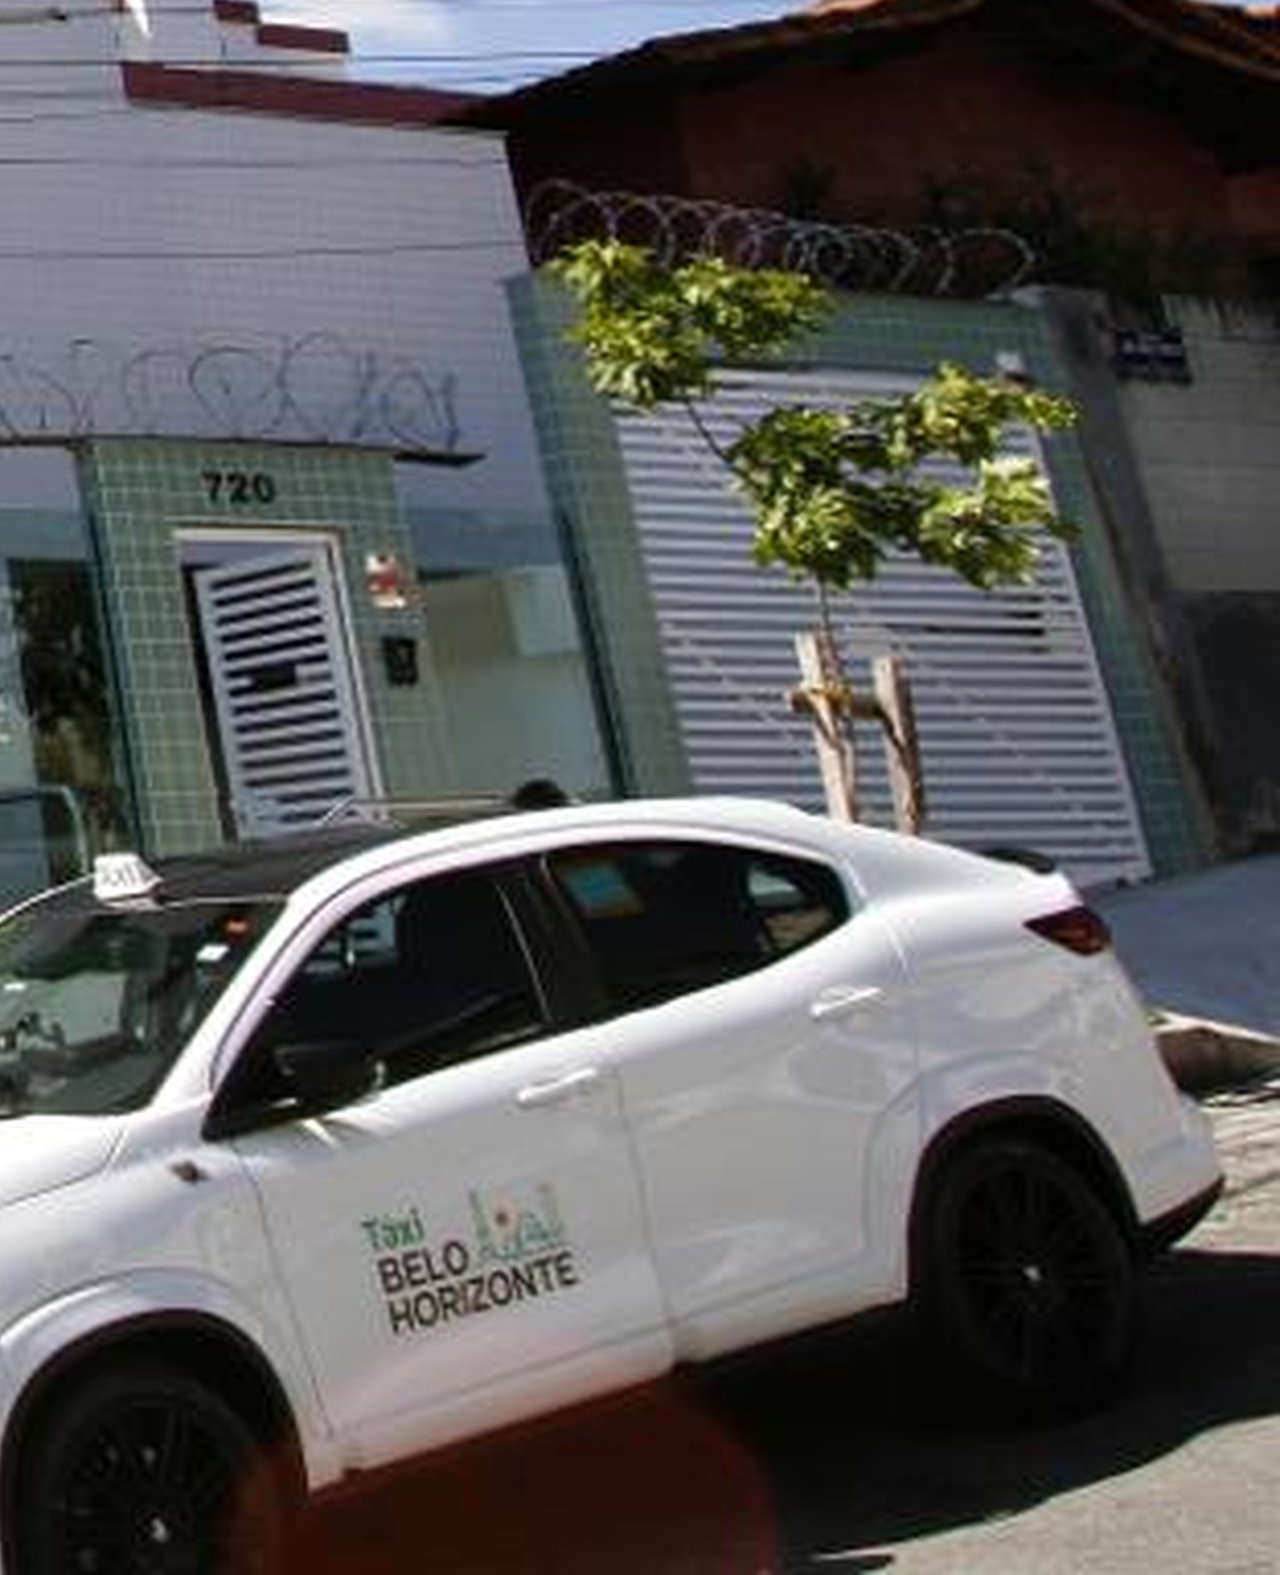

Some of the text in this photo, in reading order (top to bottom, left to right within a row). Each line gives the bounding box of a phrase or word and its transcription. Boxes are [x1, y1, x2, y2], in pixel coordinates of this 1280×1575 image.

[201, 471, 277, 504] 720
[377, 1240, 470, 1294] BELO
[389, 1250, 579, 1334] HORIZONTE
